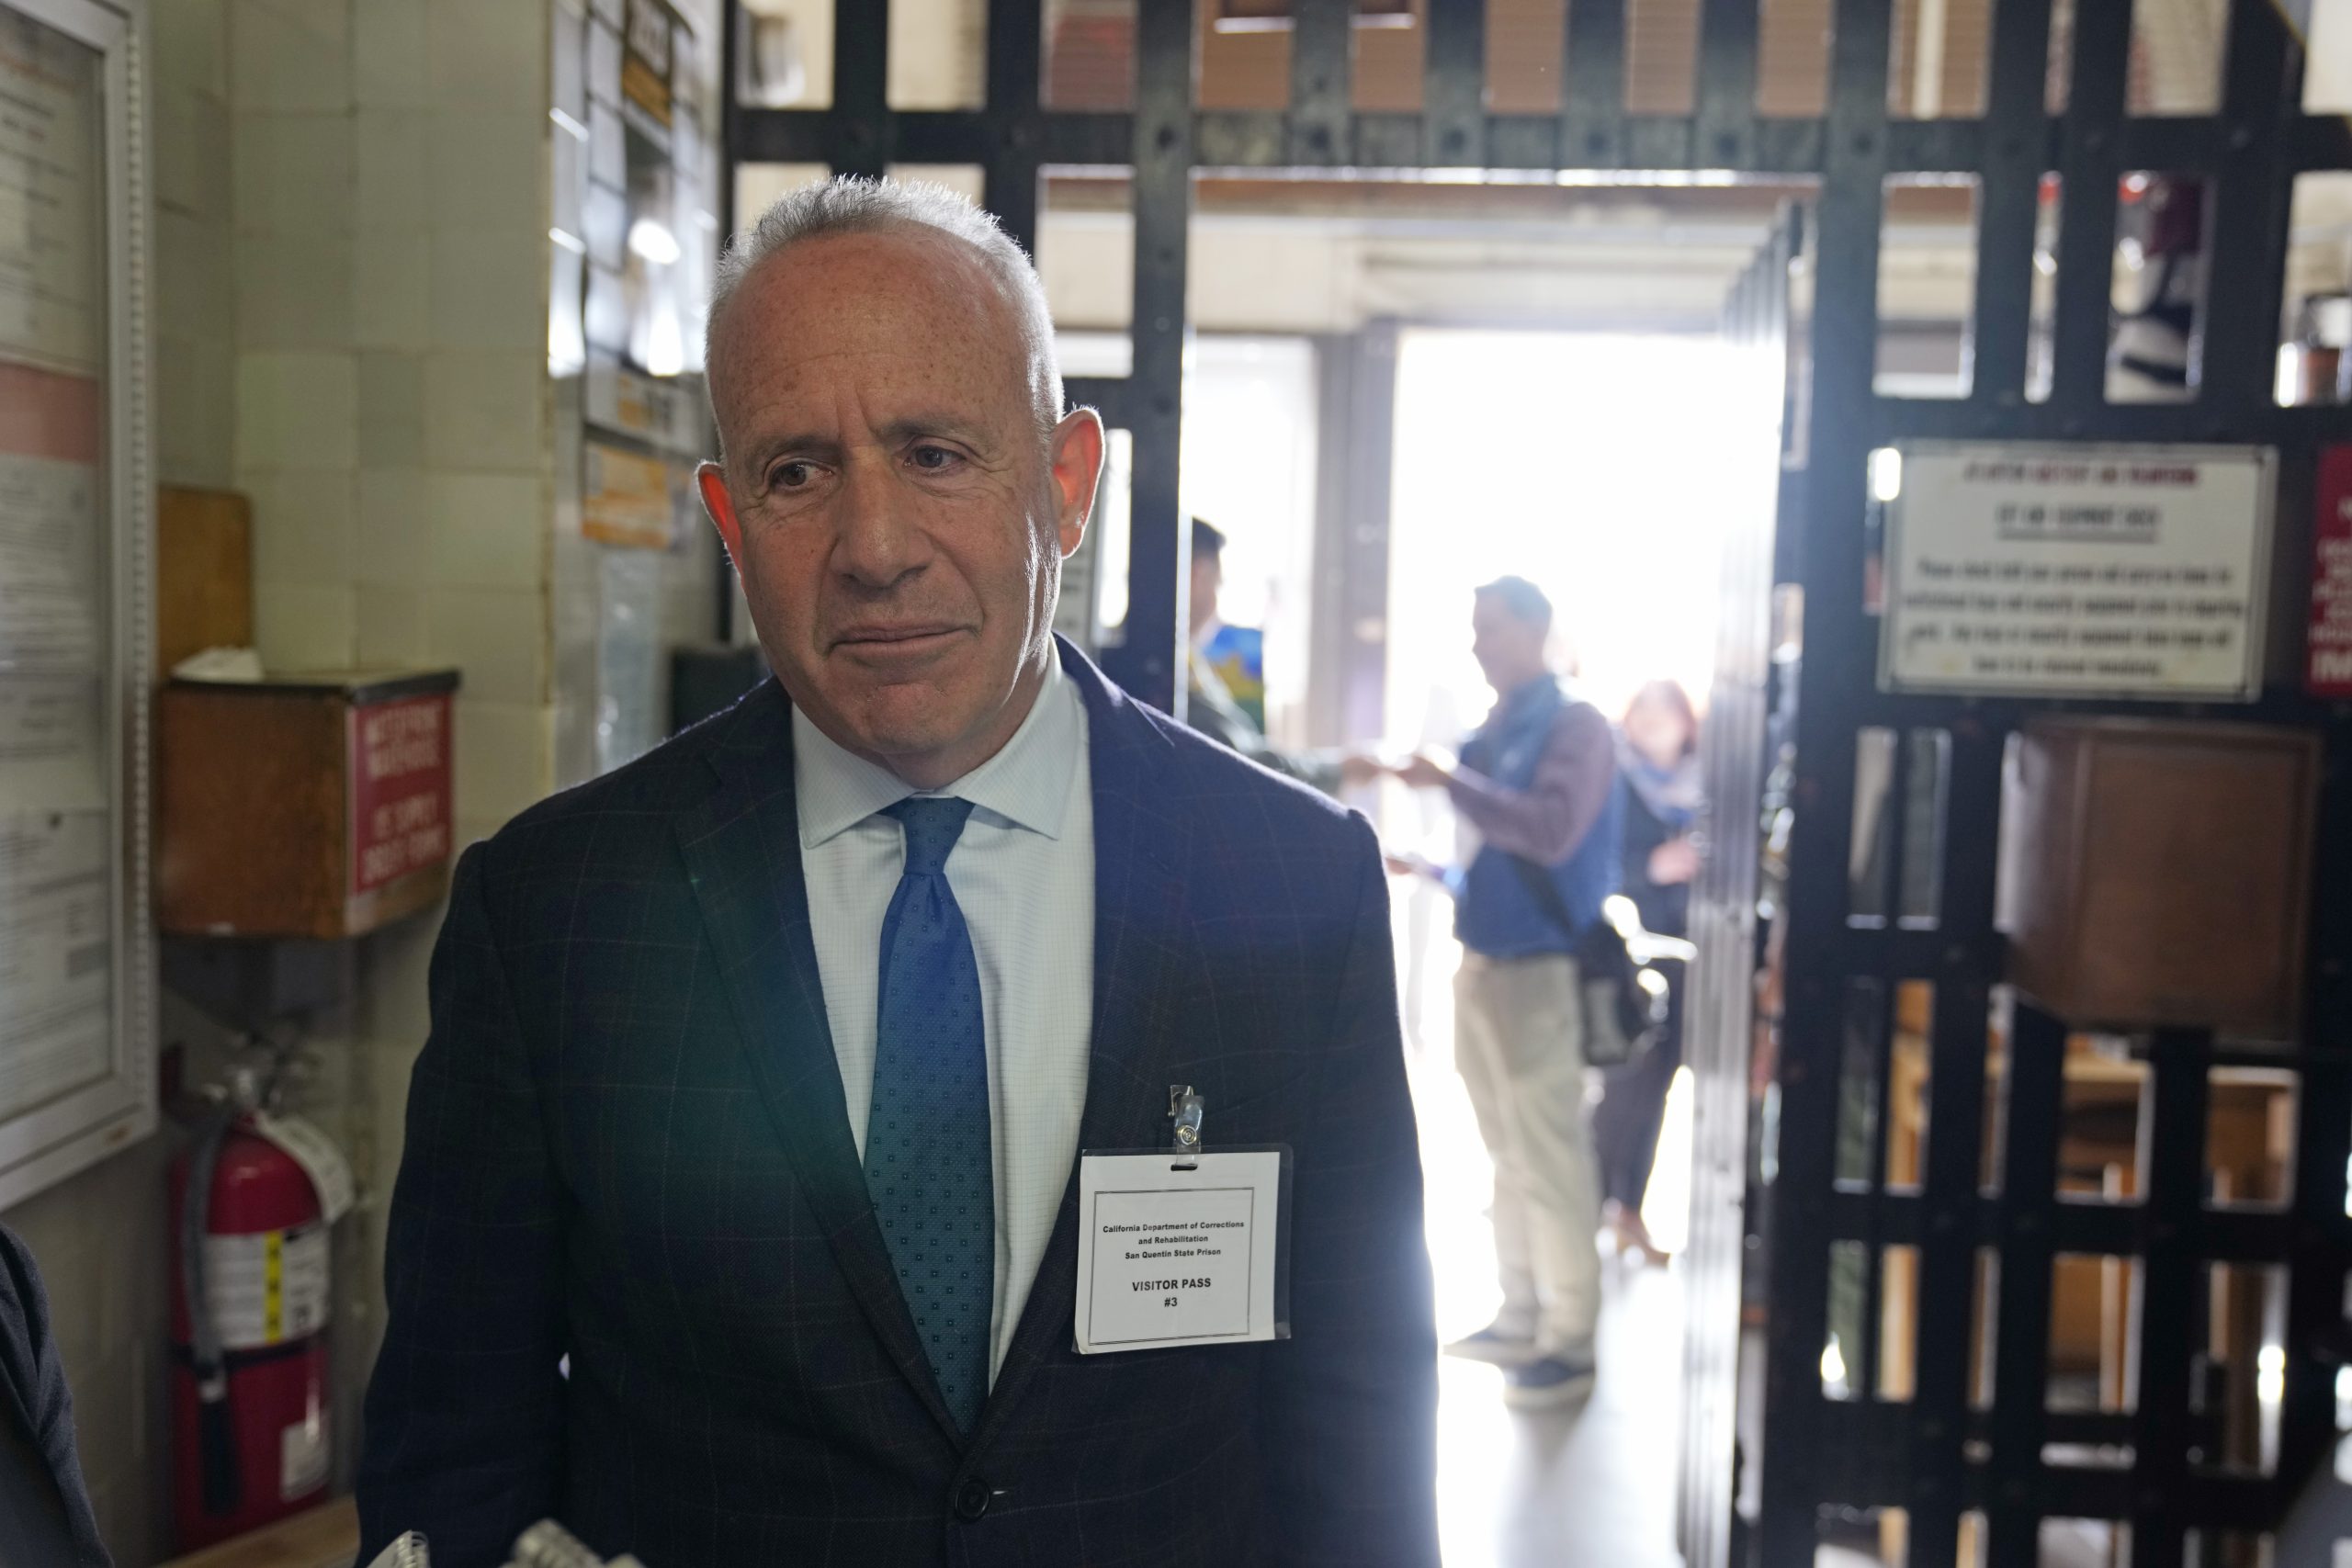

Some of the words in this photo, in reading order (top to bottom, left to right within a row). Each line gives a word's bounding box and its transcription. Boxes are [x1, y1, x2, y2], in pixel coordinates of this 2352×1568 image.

[1102, 1224, 1140, 1233] California
[1143, 1223, 1188, 1232] Department
[1200, 1221, 1244, 1229] Corrections
[1154, 1235, 1208, 1244] Rehabilitation
[1142, 1250, 1171, 1259] Quentin
[1132, 1279, 1178, 1292] VISITOR
[1182, 1278, 1211, 1289] PASS
[1164, 1296, 1178, 1307] #3
